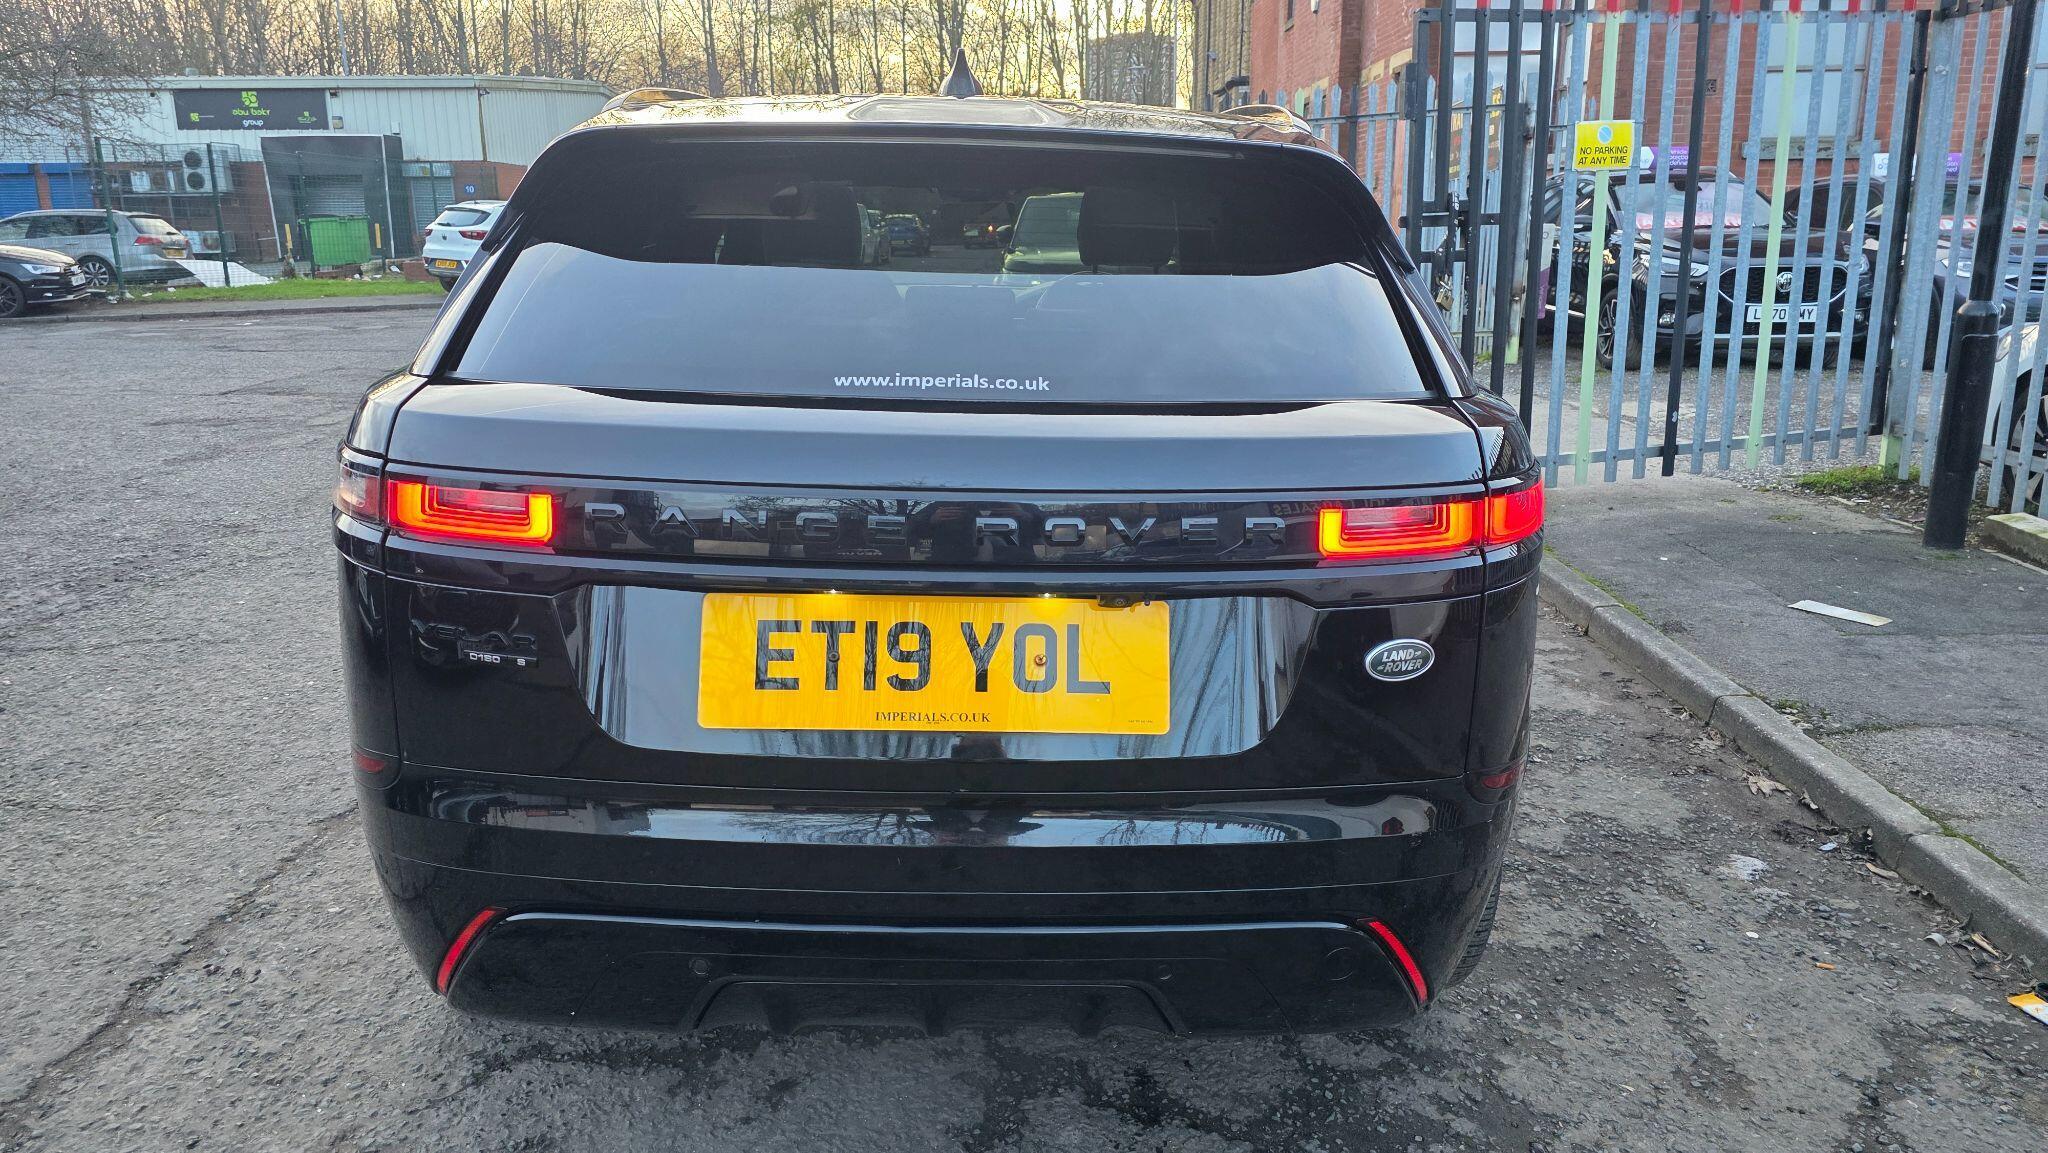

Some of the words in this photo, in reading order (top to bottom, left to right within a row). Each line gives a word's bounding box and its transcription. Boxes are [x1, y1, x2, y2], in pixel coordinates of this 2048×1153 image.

[242, 119, 264, 127] group
[1580, 147, 1592, 155] NO
[1594, 146, 1628, 155] PARKING
[1578, 157, 1588, 165] AT
[1590, 156, 1607, 165] ANY
[1610, 156, 1628, 164] TIME
[465, 185, 475, 193] 10
[1754, 308, 1787, 320] L70
[834, 372, 1050, 391] www.imperials.co.uk
[584, 502, 907, 546] RANGE
[975, 517, 1286, 546] ROVER
[469, 653, 501, 663] D180
[516, 658, 526, 666] S
[754, 619, 932, 693] ET19
[960, 622, 1111, 695] YOL
[1382, 648, 1415, 662] LAND
[1384, 659, 1423, 672] ROVER
[875, 711, 991, 723] IMPERIALS.CO.UK
